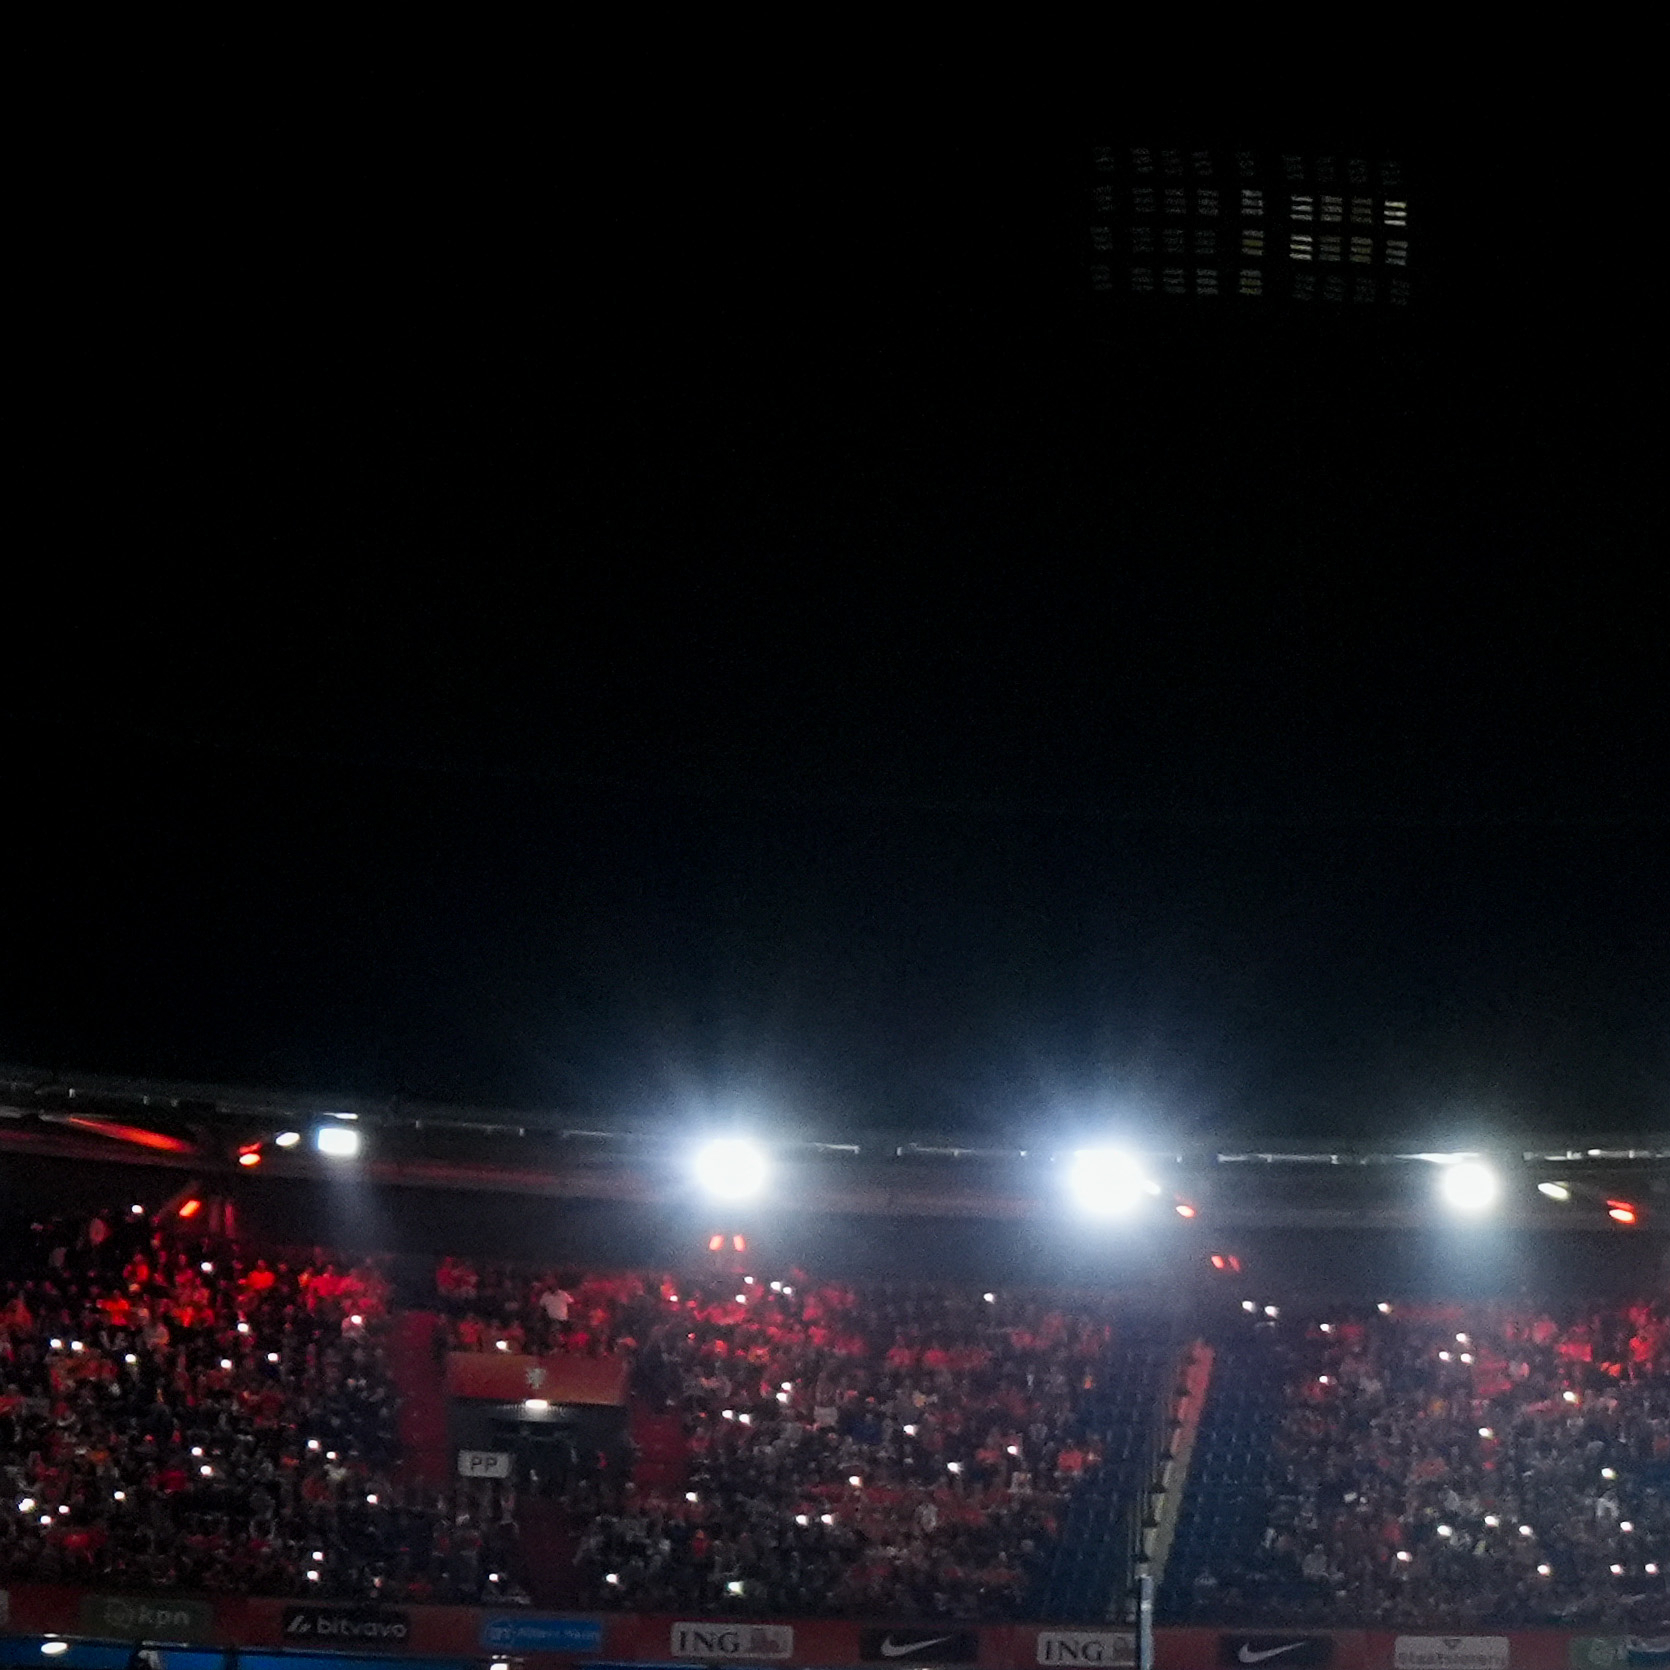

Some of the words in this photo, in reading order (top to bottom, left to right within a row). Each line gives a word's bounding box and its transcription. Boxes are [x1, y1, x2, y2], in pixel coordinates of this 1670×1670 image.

[471, 1457, 497, 1471] PP
[138, 1606, 191, 1628] kpn
[317, 1616, 408, 1638] bitvavo
[679, 1630, 740, 1654] ING
[1044, 1640, 1102, 1663] ING
